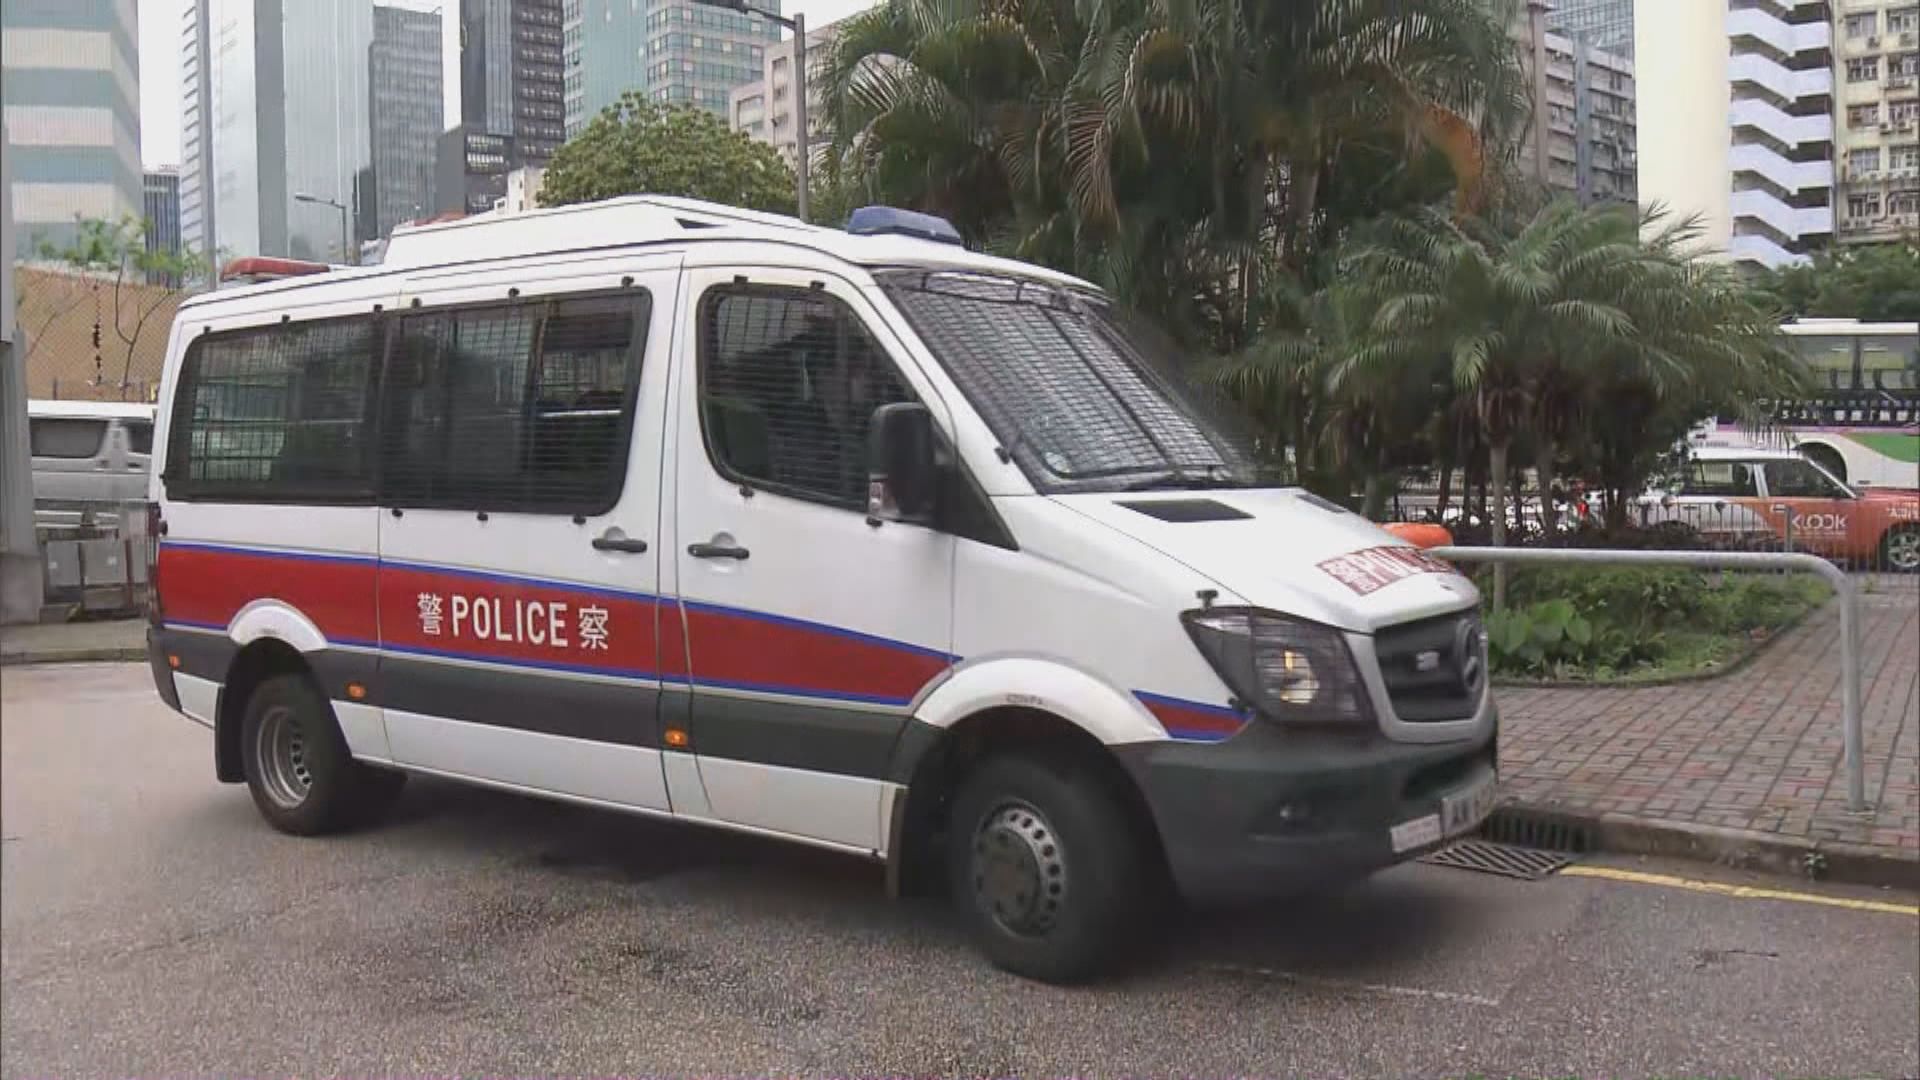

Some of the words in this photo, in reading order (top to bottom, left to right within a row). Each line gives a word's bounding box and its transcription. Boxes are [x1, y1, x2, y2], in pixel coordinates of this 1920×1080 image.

[1792, 514, 1848, 529] KLOOK
[417, 592, 443, 635] 警
[451, 595, 568, 647] POLICE
[578, 604, 609, 649] 察
